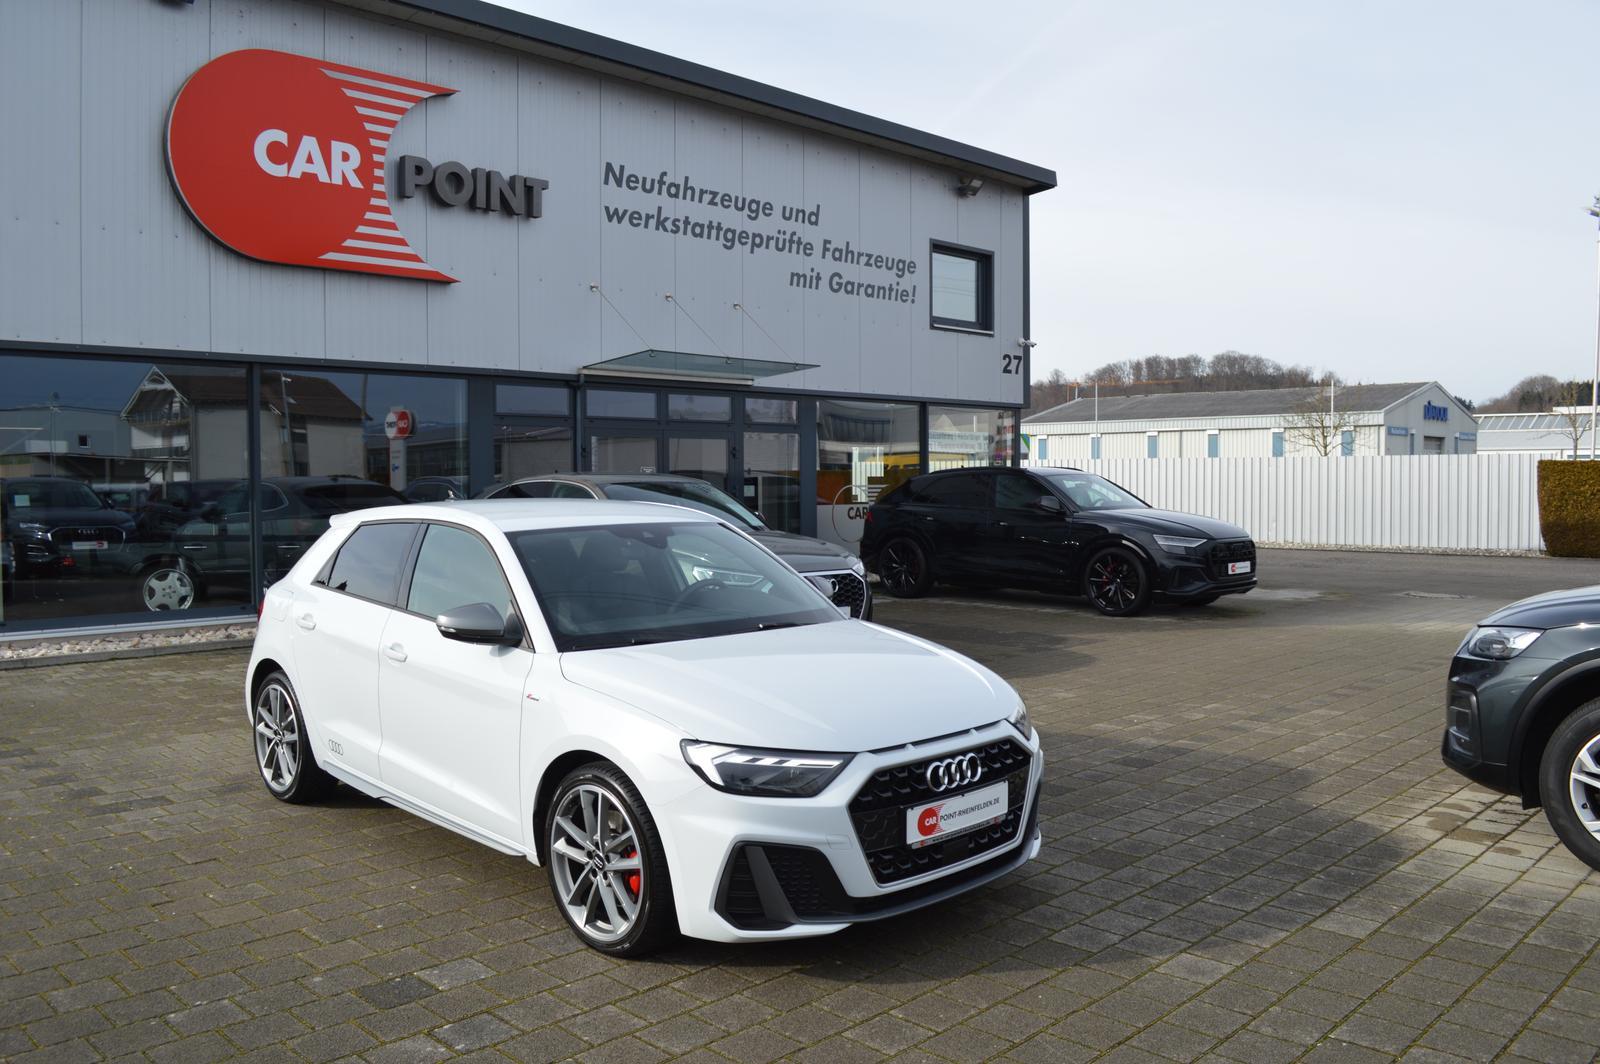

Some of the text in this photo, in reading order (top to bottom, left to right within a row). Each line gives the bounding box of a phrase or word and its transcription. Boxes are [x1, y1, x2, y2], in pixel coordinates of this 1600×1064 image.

[253, 128, 549, 219] CAR POINT
[603, 161, 820, 226] Neufahrzeuge und
[603, 205, 917, 278] werkstattgeprüfte Fahrzeuge
[789, 267, 917, 305] mit Garantie!
[1002, 353, 1023, 375] 27
[924, 797, 1000, 826] CAR POINT-RHEINFELDEN.DE
